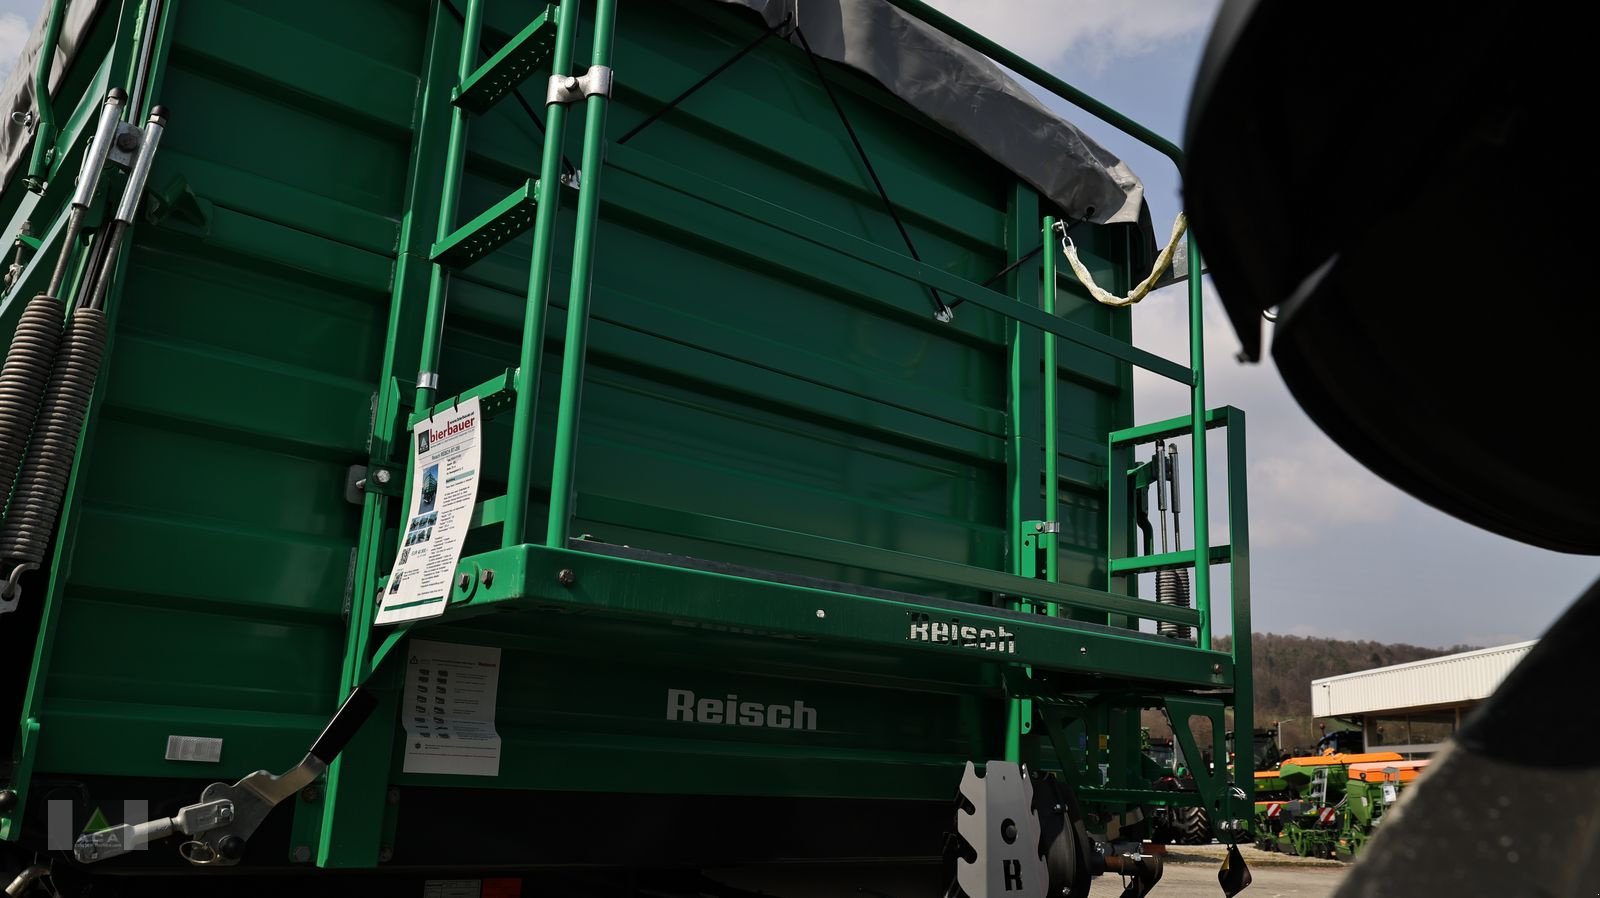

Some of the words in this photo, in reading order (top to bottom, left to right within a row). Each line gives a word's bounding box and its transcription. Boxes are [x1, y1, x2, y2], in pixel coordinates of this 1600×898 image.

[430, 417, 475, 443] bierbauer
[910, 612, 1015, 654] Reisch
[666, 688, 817, 731] Reisch
[1003, 859, 1023, 891] R
